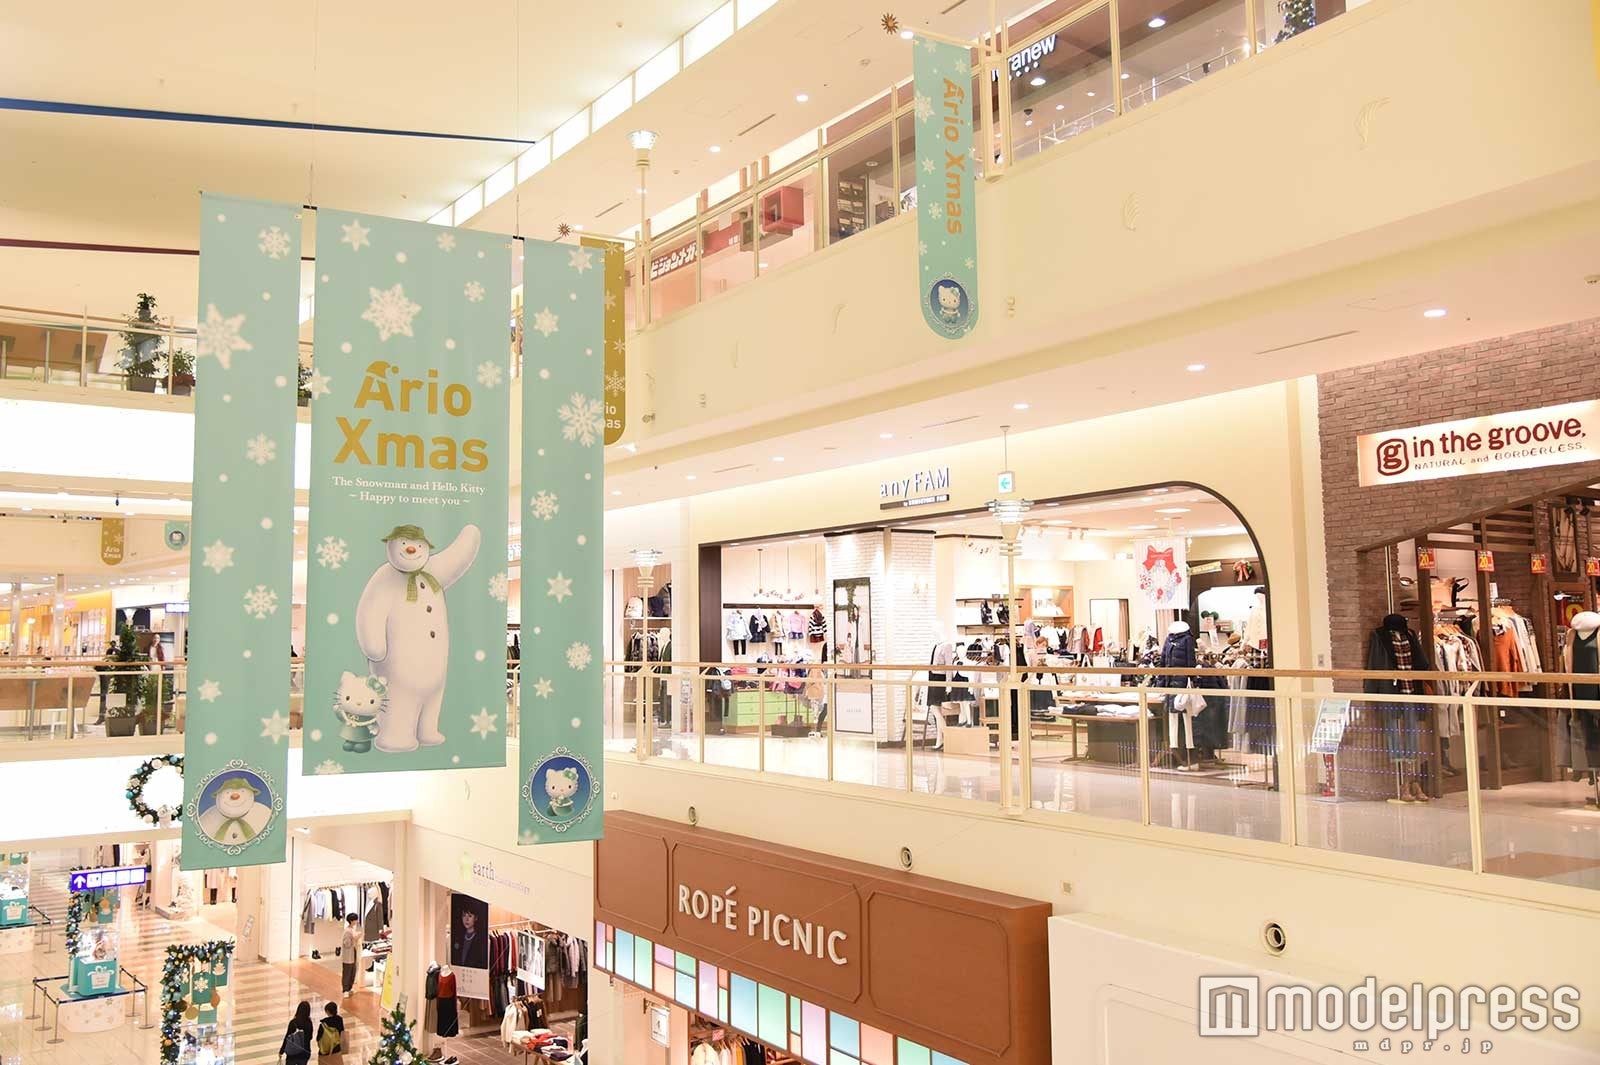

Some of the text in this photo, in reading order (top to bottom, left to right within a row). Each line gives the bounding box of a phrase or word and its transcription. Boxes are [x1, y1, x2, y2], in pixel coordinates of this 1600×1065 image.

[991, 34, 1056, 82] ranew
[943, 76, 966, 235] Ario Xmas
[354, 360, 472, 416] Ario
[605, 401, 617, 415] io
[606, 419, 621, 429] as
[333, 416, 489, 472] Xmas
[1413, 436, 1434, 458] in
[1440, 430, 1482, 453] the
[1414, 459, 1467, 470] NATURAL
[1470, 455, 1489, 464] and
[332, 476, 486, 496] The Snowman and Hello Kitty
[914, 465, 950, 493] FAM
[360, 491, 397, 505] Happy
[399, 494, 411, 504] to
[412, 495, 438, 505] meet
[441, 498, 460, 507] you
[473, 860, 495, 880] earth
[678, 884, 848, 965] ROPÉ PICNIC
